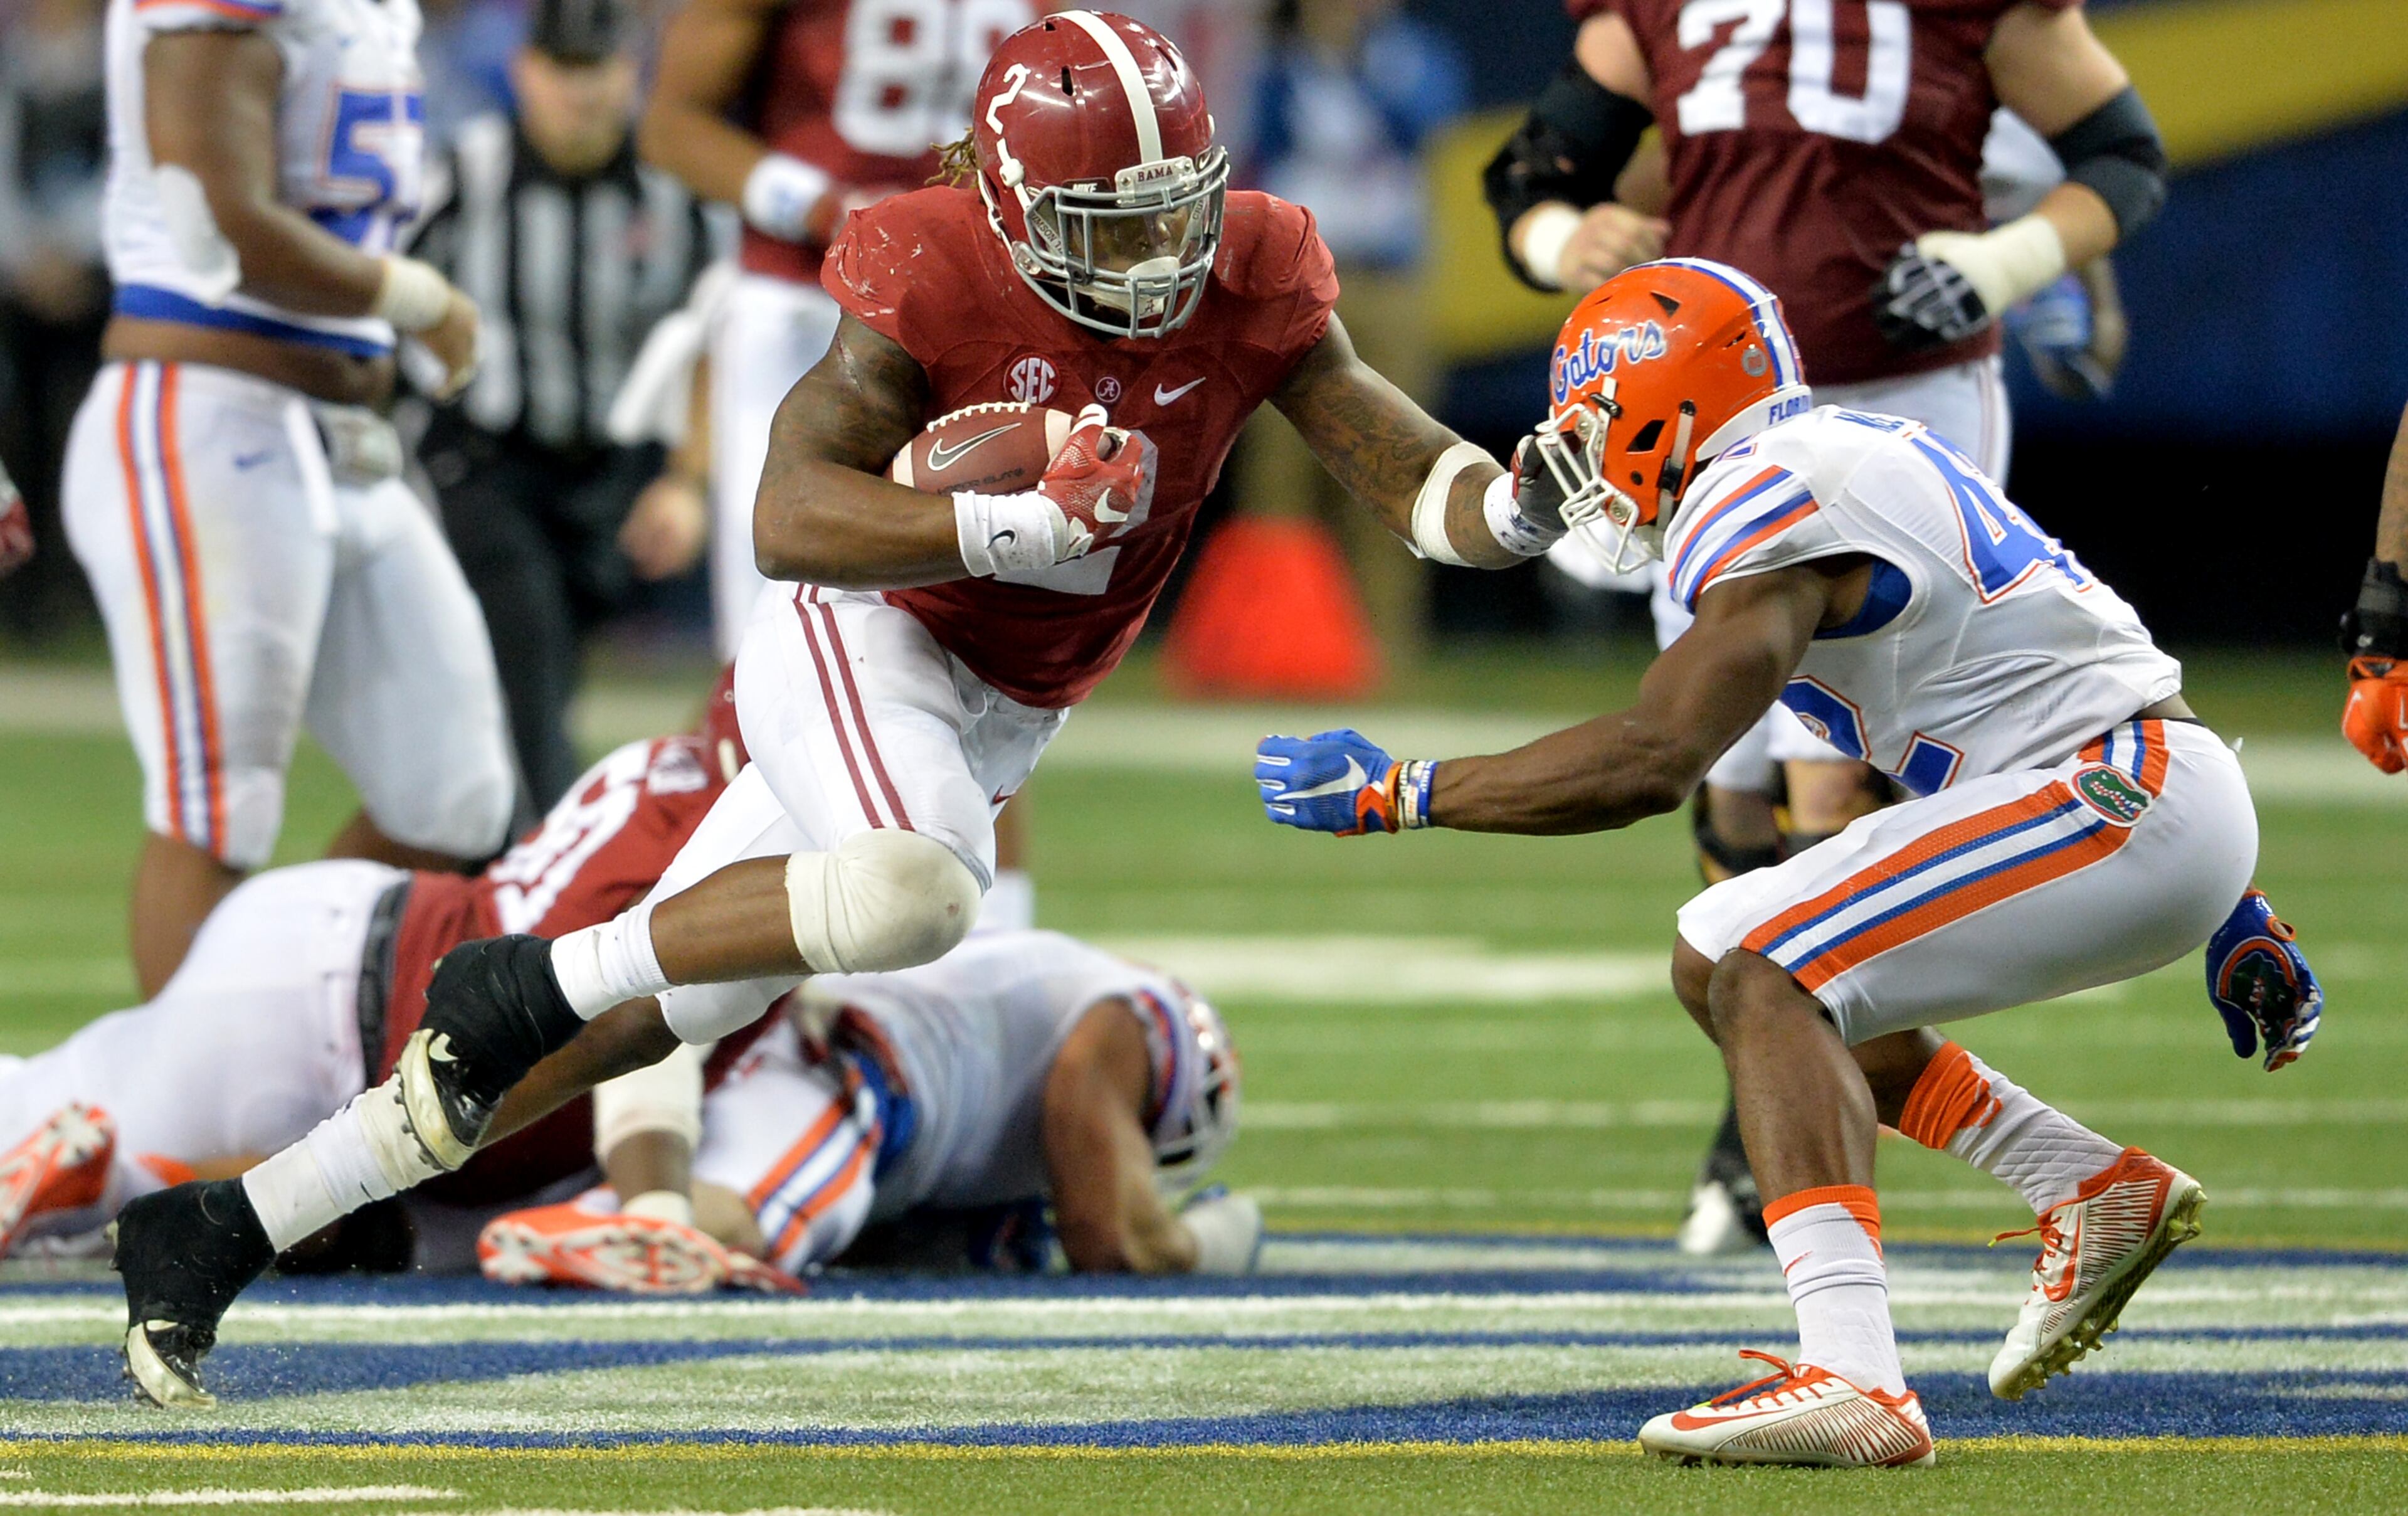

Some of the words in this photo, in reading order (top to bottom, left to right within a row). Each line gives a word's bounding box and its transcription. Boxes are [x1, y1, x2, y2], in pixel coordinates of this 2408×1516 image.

[986, 63, 1030, 135] 2
[1677, 0, 1913, 145] 70
[1137, 164, 1174, 183] BAMA
[1010, 357, 1056, 403] SEC
[1551, 320, 1669, 405] Gators
